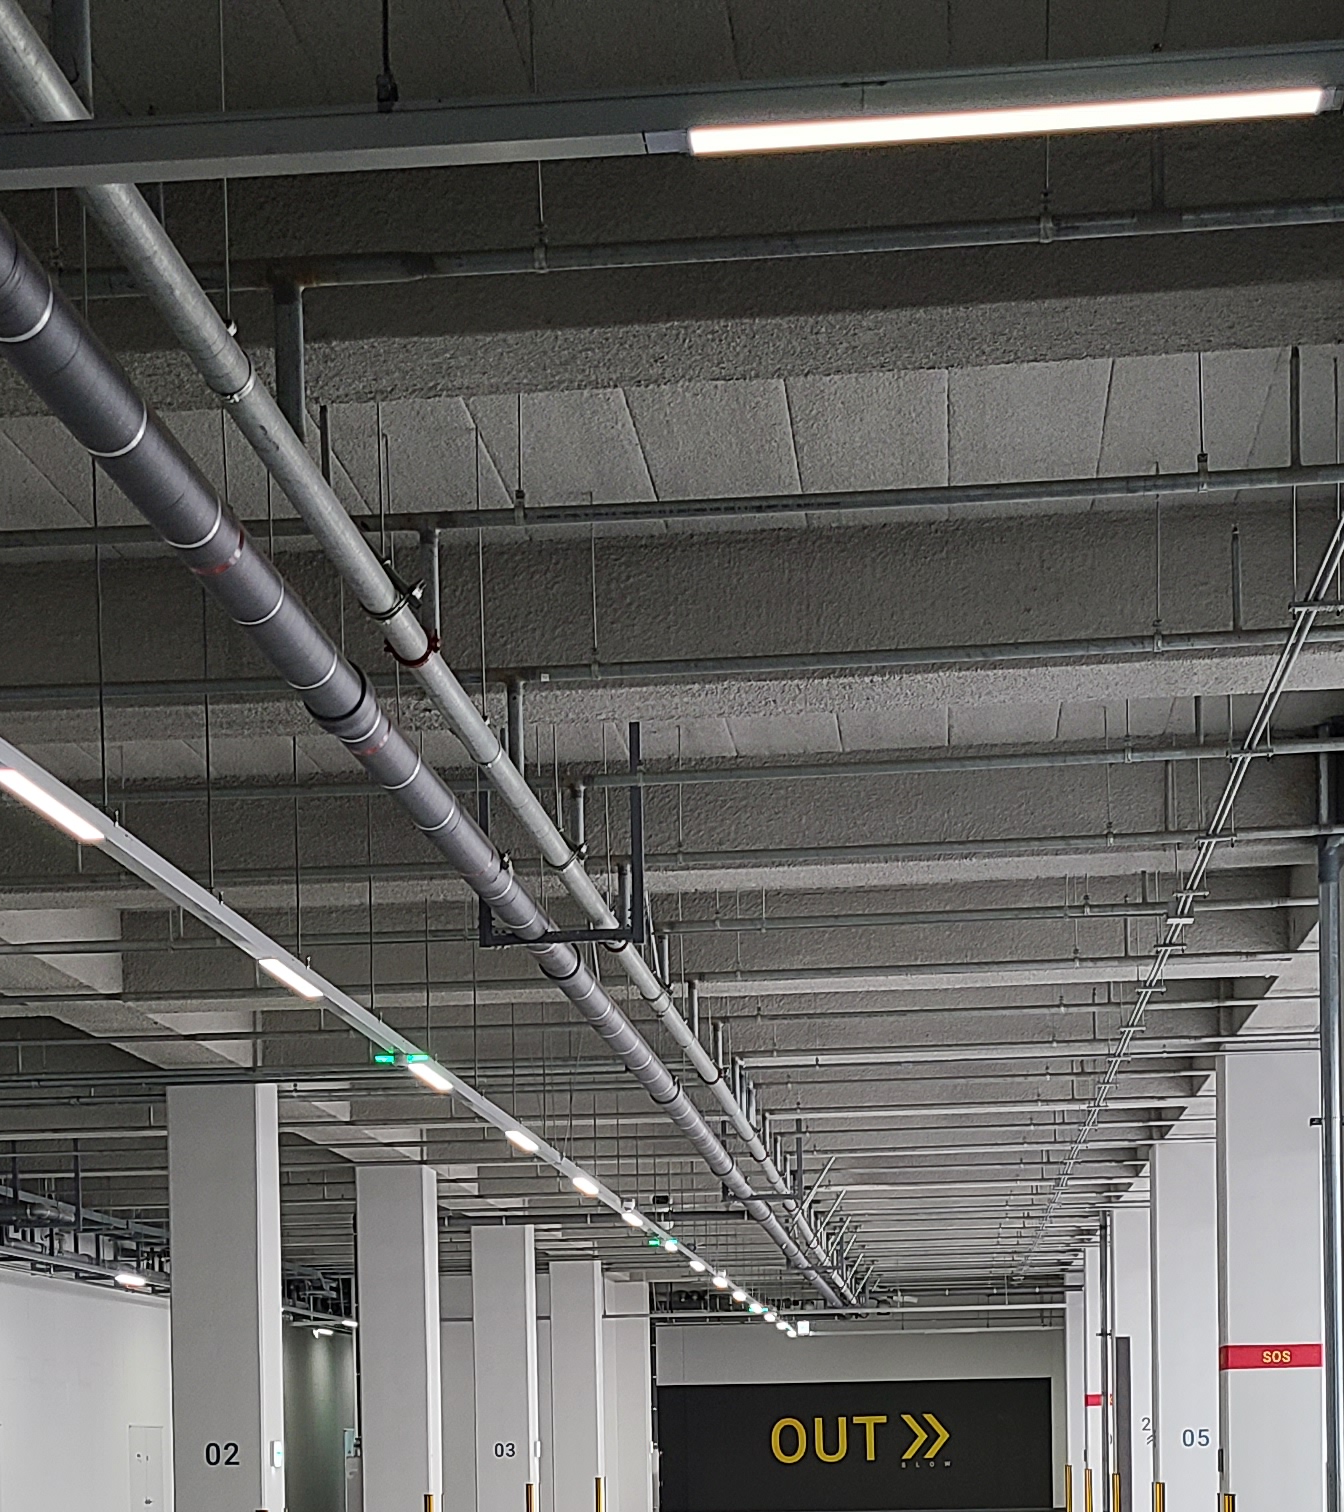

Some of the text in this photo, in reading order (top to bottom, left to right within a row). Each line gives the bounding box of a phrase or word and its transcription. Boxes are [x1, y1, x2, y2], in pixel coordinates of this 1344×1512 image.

[1262, 1350, 1291, 1363] SOS
[770, 1415, 888, 1464] OUT
[1182, 1428, 1210, 1448] 05
[204, 1441, 241, 1467] 02
[493, 1441, 517, 1459] 03
